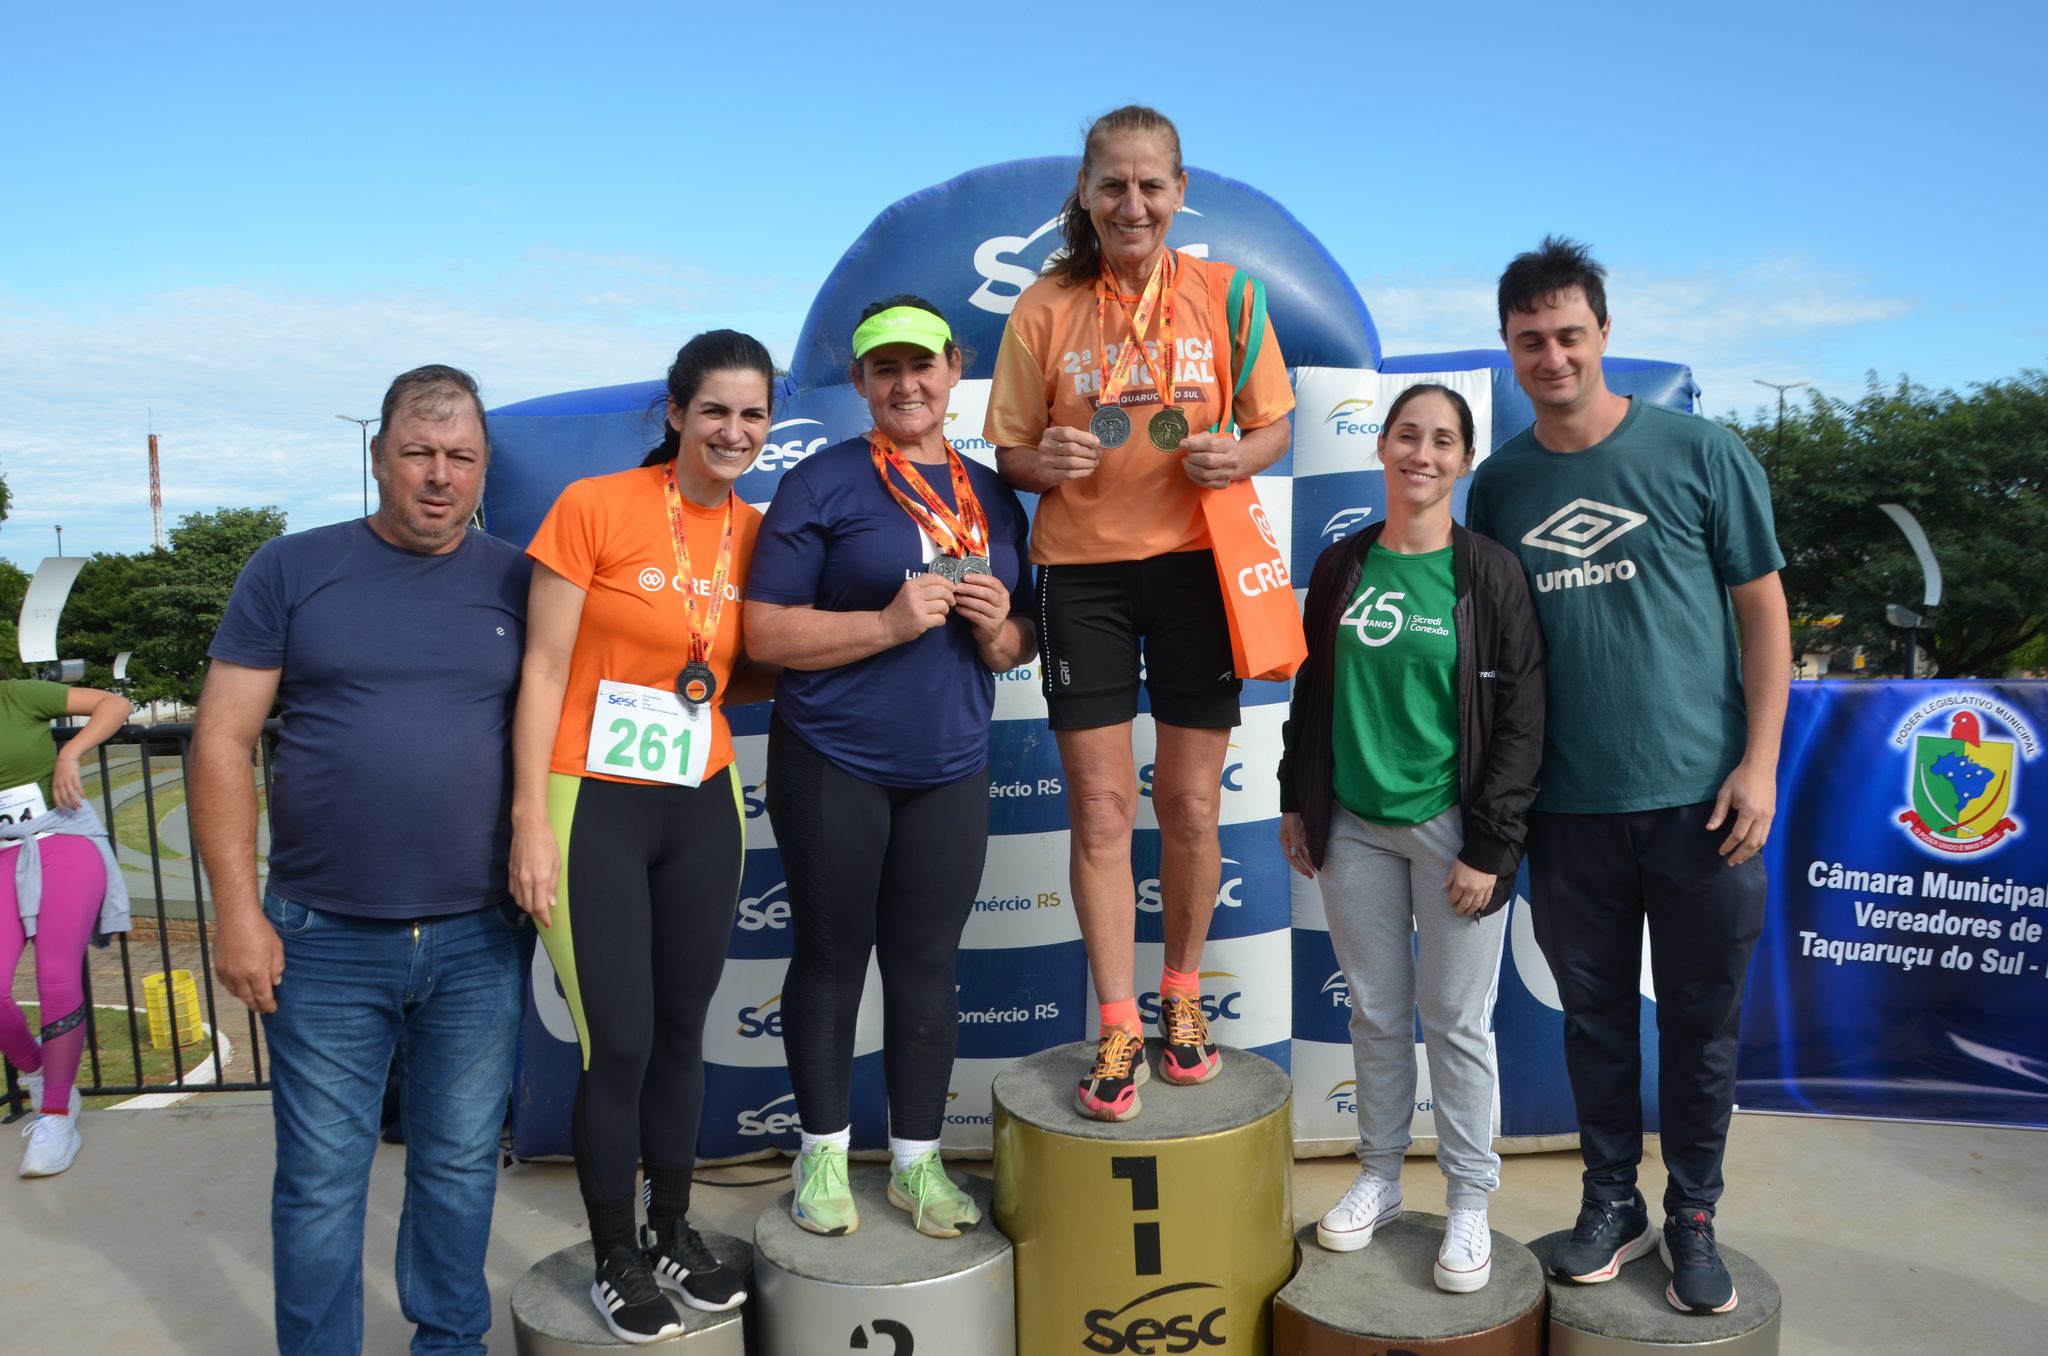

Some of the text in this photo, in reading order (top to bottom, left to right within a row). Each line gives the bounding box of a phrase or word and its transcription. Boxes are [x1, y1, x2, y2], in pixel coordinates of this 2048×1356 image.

[1104, 338, 1213, 366] RSICA
[1074, 361, 1214, 396] REIOAL
[1183, 390, 1199, 398] SUL
[672, 575, 742, 602] CREOL
[1238, 558, 1290, 596] CRE
[1536, 559, 1636, 592] umbro
[1340, 586, 1405, 646] 45
[1367, 619, 1393, 630] ANOS
[1410, 623, 1449, 636] Conexão
[1411, 614, 1442, 626] Sicredi
[1478, 669, 1496, 679] redi
[1895, 696, 2036, 756] PODER LEGISLATIVO MUNICIPAL
[604, 718, 692, 776] 261
[989, 778, 1062, 798] ércio RS
[1808, 860, 1914, 896] Câmara
[974, 892, 1061, 912] mércio RS
[1854, 901, 2043, 943] Vereadores de
[1799, 930, 1933, 971] Taquaruçu
[1940, 945, 1974, 971] do
[1980, 948, 2025, 975] Sul
[958, 1002, 1060, 1024] omércio RS
[1138, 990, 1242, 1025] Ssc
[1111, 1155, 1162, 1276] 1
[1082, 1300, 1227, 1356] Sesc
